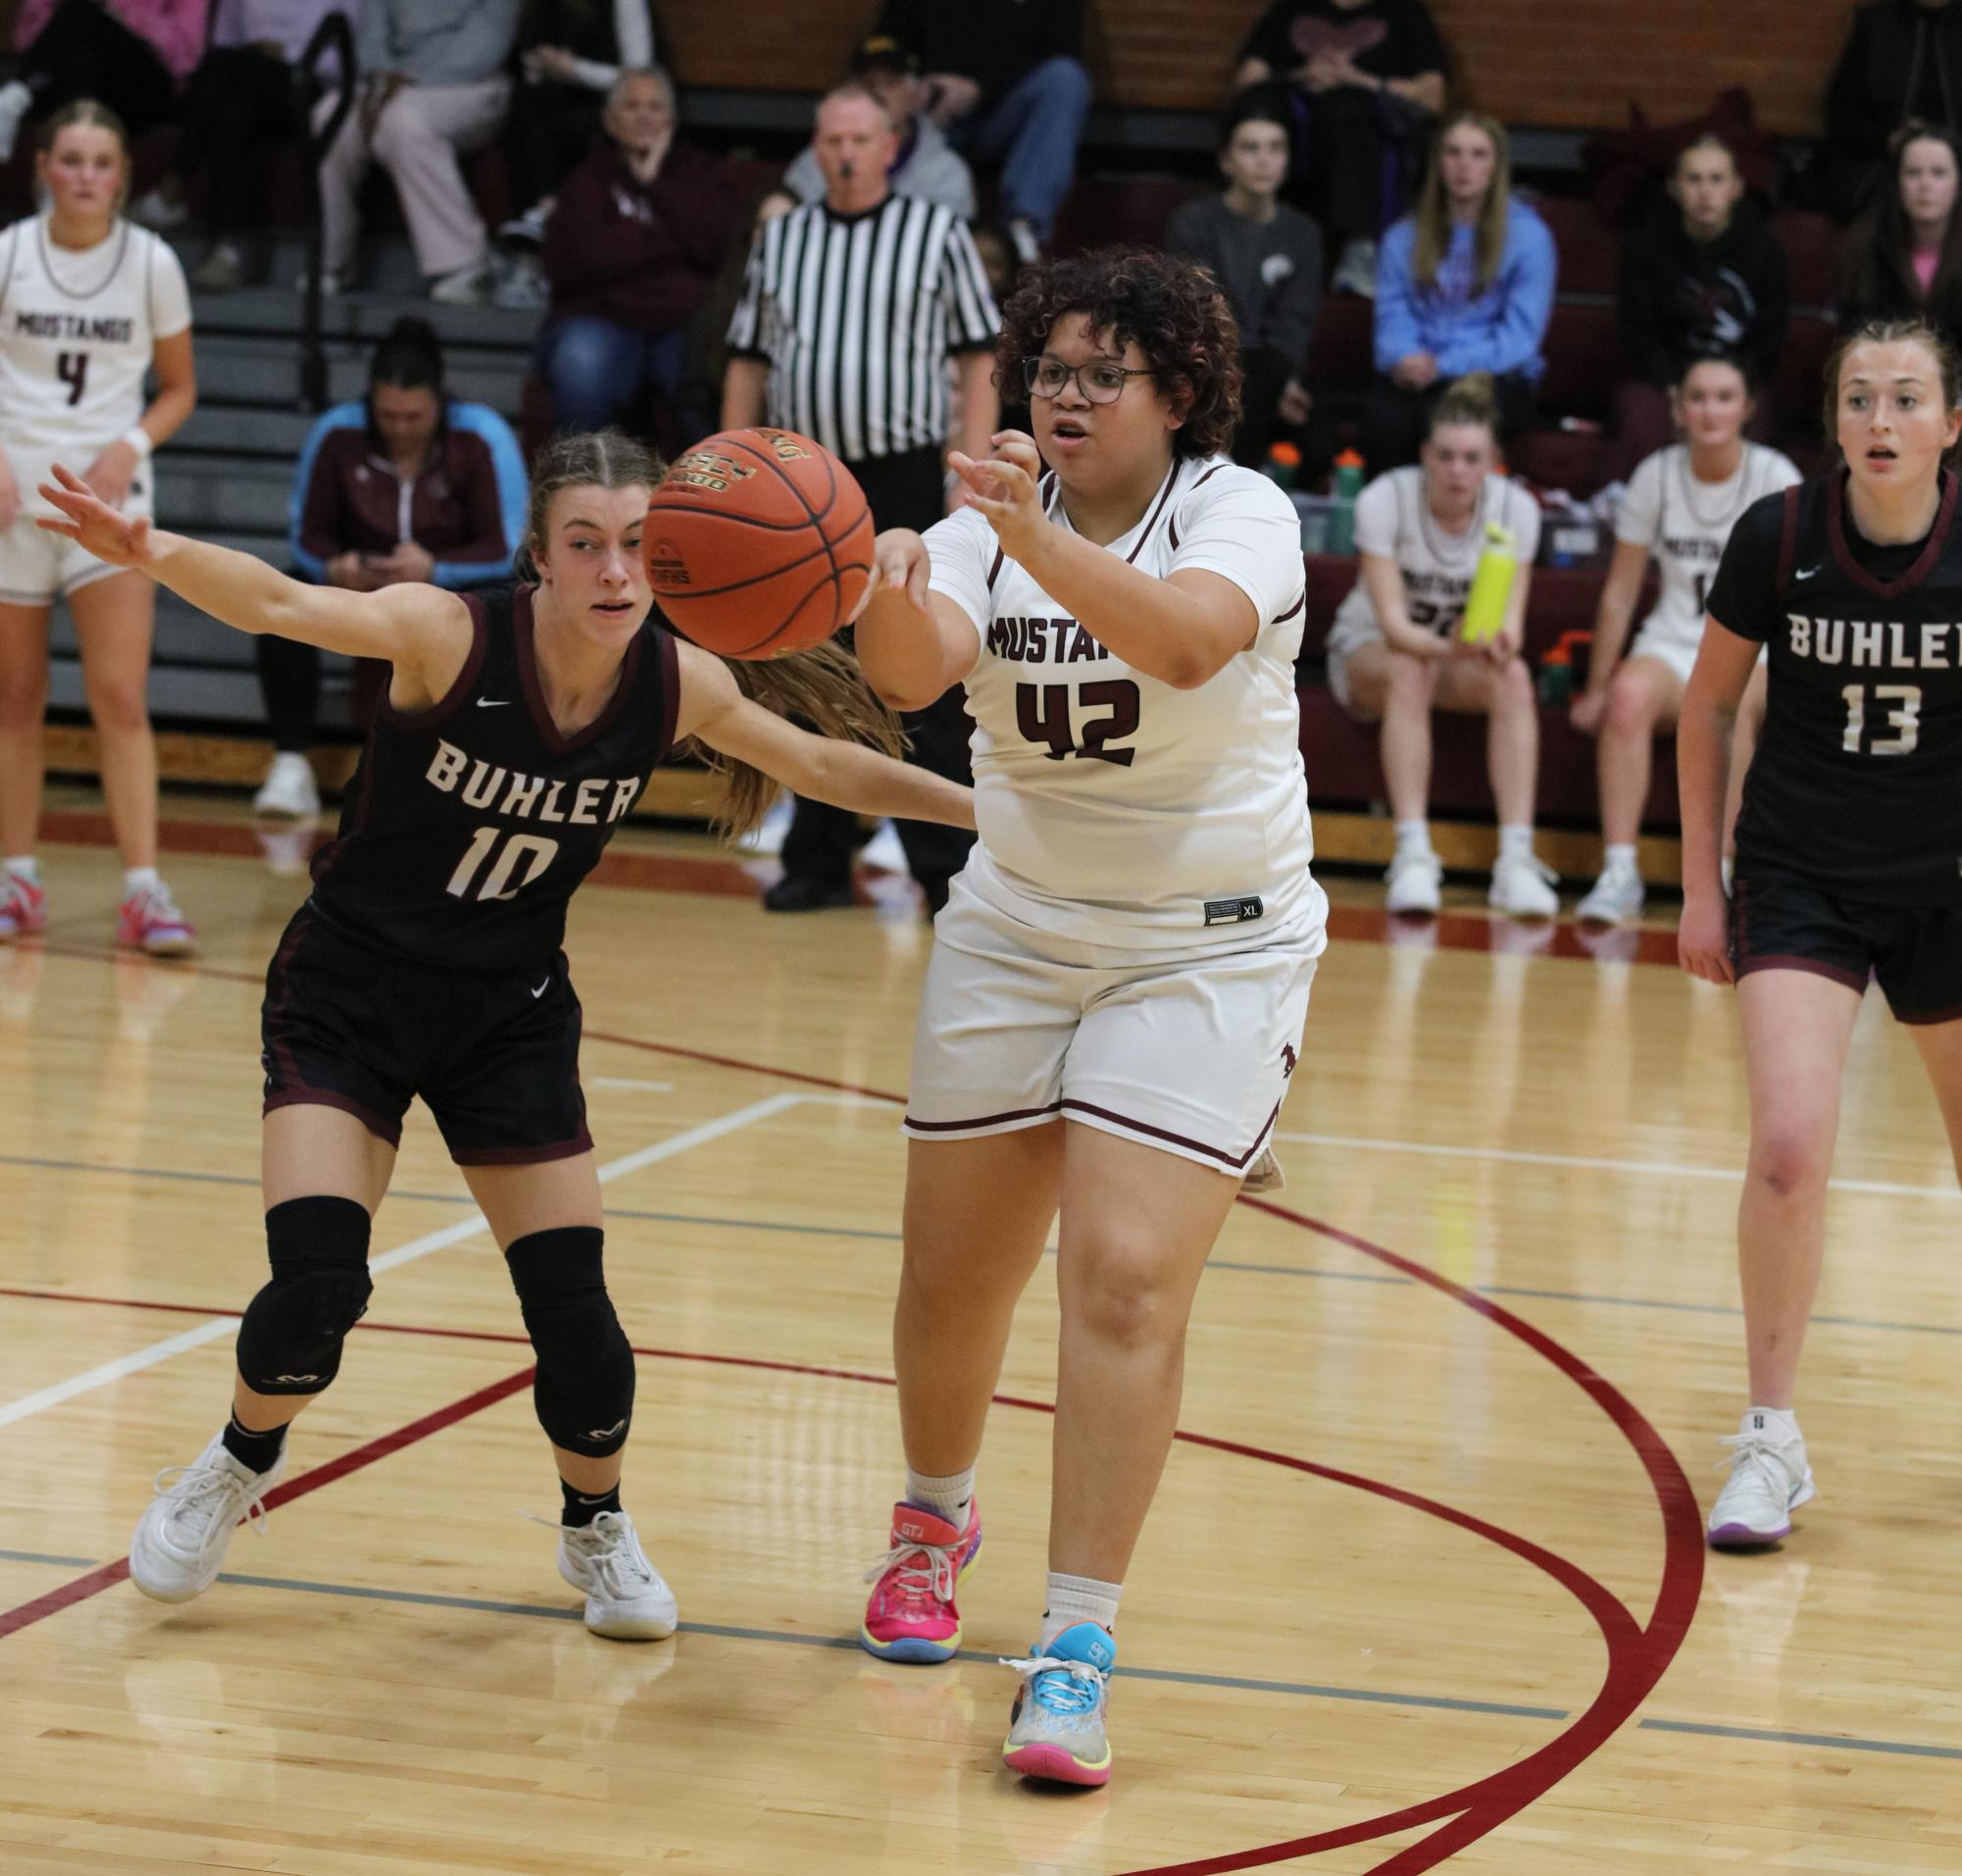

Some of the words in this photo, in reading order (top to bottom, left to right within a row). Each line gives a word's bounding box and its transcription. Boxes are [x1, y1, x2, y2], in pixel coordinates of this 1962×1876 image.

[57, 352, 89, 407] 4
[986, 617, 1109, 664] MUSTA
[1016, 679, 1140, 767] 42
[1841, 684, 1923, 755] 13
[426, 737, 640, 825] BUHLER
[445, 827, 560, 901] 10
[1242, 905, 1259, 917] XL
